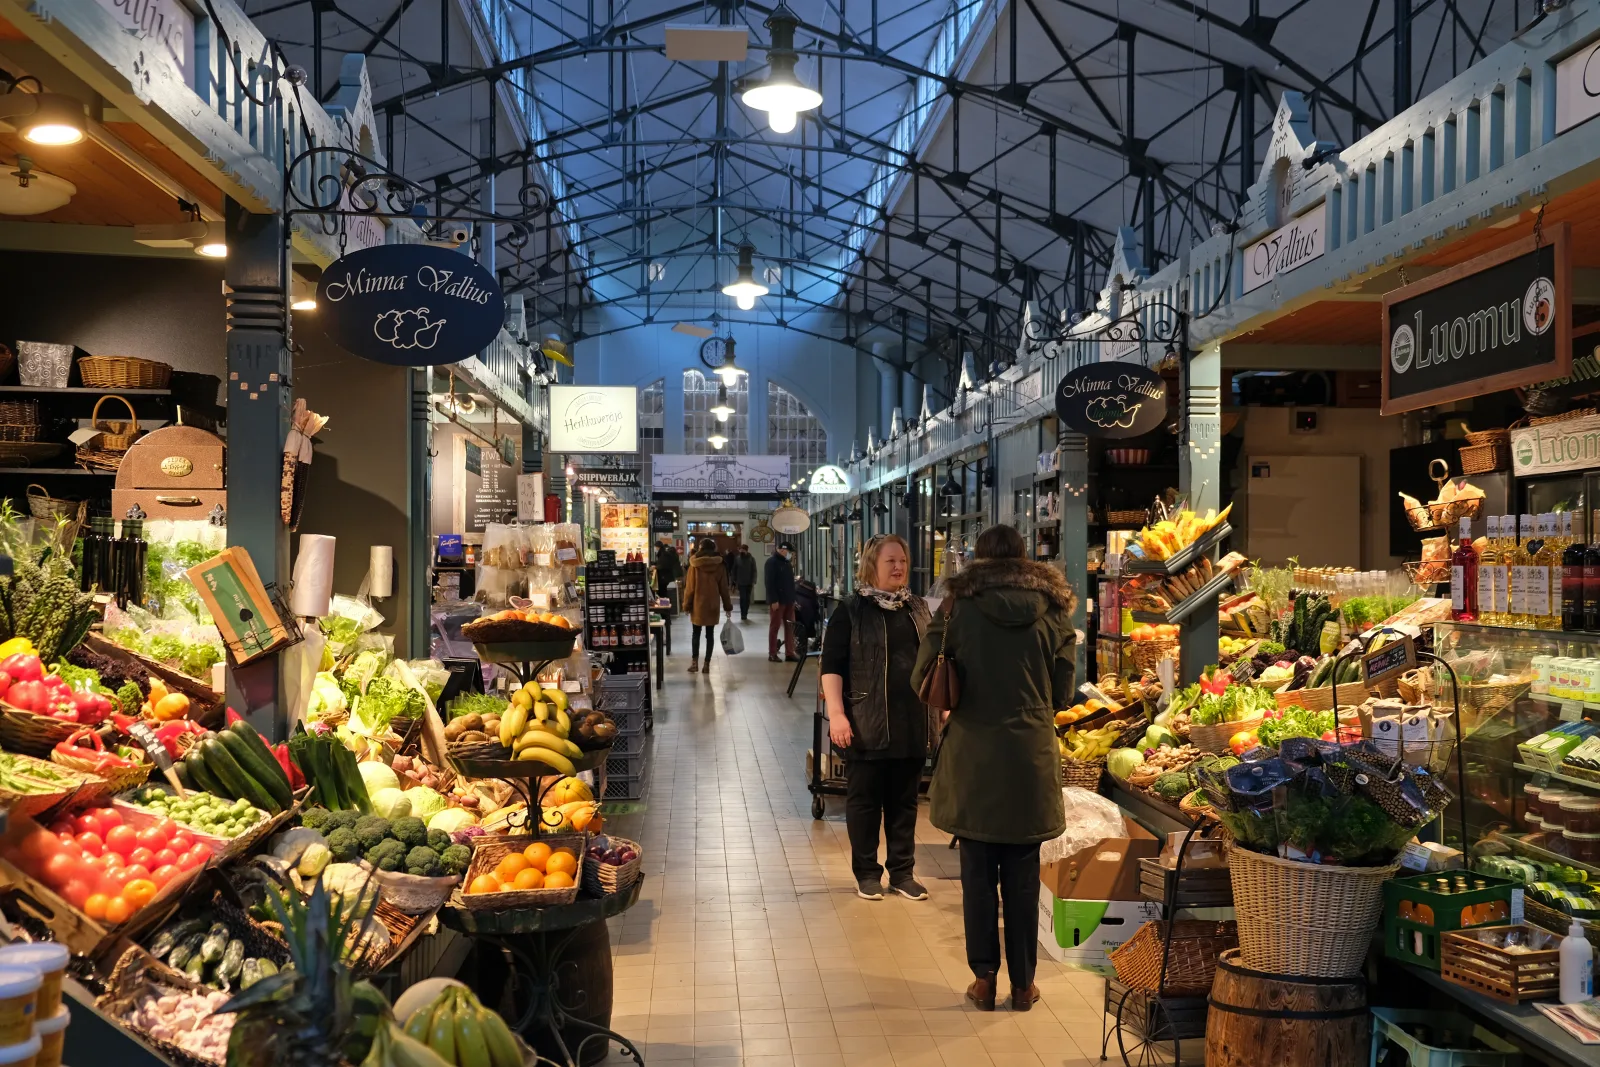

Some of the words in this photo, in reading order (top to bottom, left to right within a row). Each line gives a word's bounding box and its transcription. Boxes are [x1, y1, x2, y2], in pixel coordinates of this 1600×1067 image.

[1254, 226, 1318, 279] Vallius
[326, 268, 408, 301] Minna
[417, 266, 492, 304] Vallius
[1414, 298, 1520, 369] Luomu
[1063, 376, 1112, 398] Minna
[1118, 374, 1164, 400] Vallius
[578, 472, 636, 483] SIIPIWERÄJÄ
